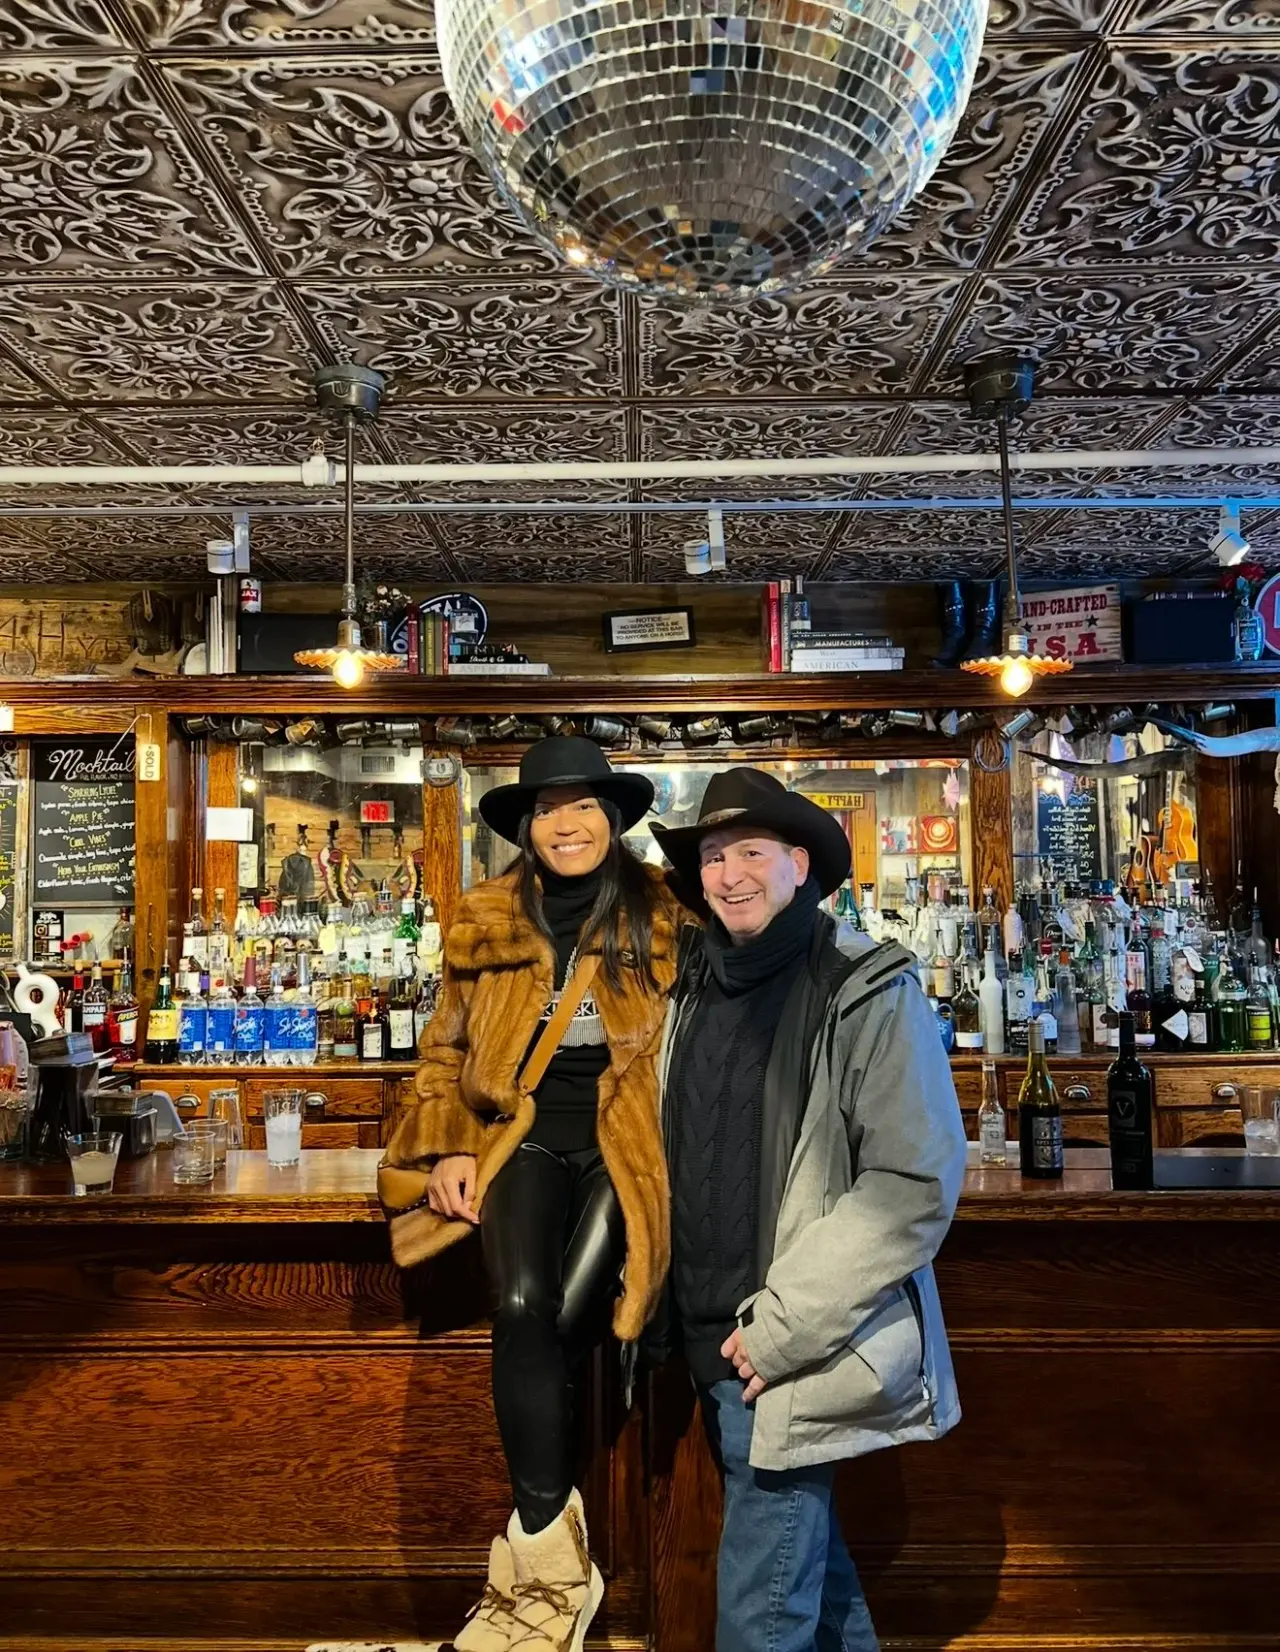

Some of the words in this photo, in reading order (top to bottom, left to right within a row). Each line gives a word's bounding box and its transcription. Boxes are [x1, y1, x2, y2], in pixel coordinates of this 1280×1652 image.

[1022, 594, 1108, 618] AND-CRAFTED
[1037, 623, 1052, 631] IN
[1055, 620, 1084, 629] THE
[803, 661, 859, 670] AMERICAN
[145, 750, 155, 778] SOLD
[83, 1005, 106, 1013] AMPARI
[1116, 1101, 1130, 1116] V
